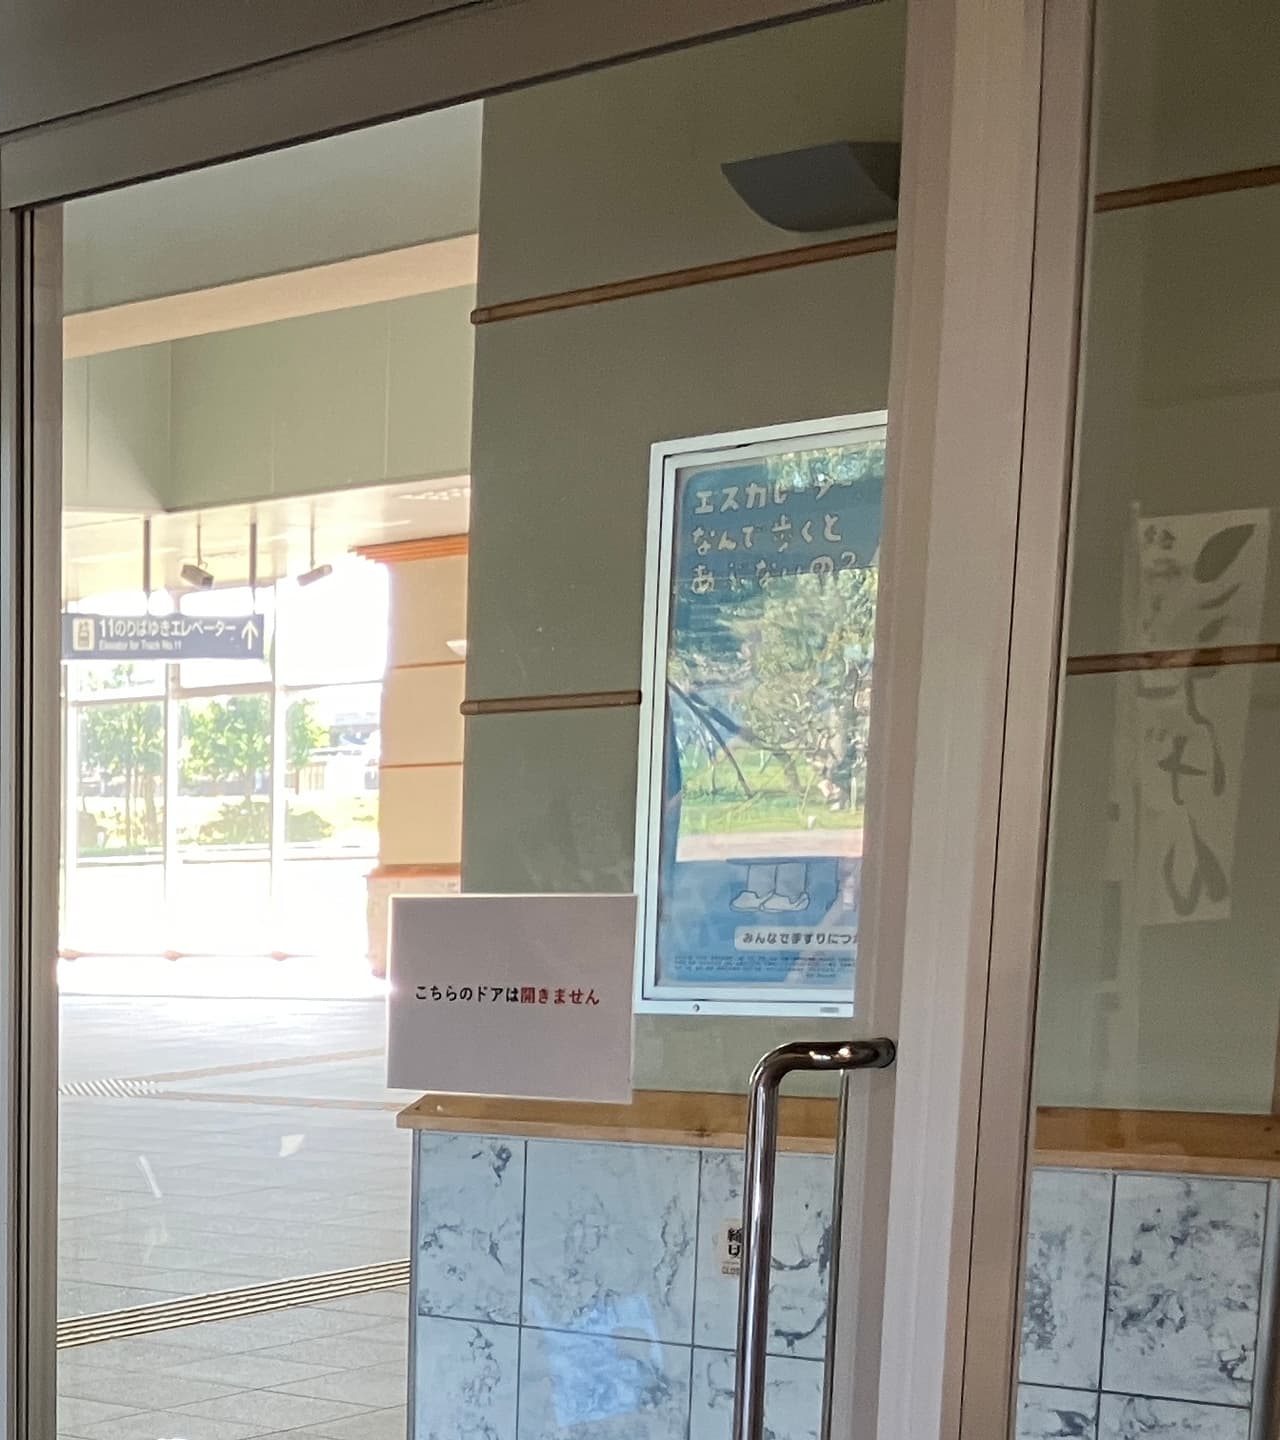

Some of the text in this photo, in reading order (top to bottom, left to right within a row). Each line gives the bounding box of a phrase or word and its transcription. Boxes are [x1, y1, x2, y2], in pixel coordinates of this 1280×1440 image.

[742, 930, 857, 945] みんなで手すりにつ
[415, 984, 600, 1006] こちらのドアは開きません
